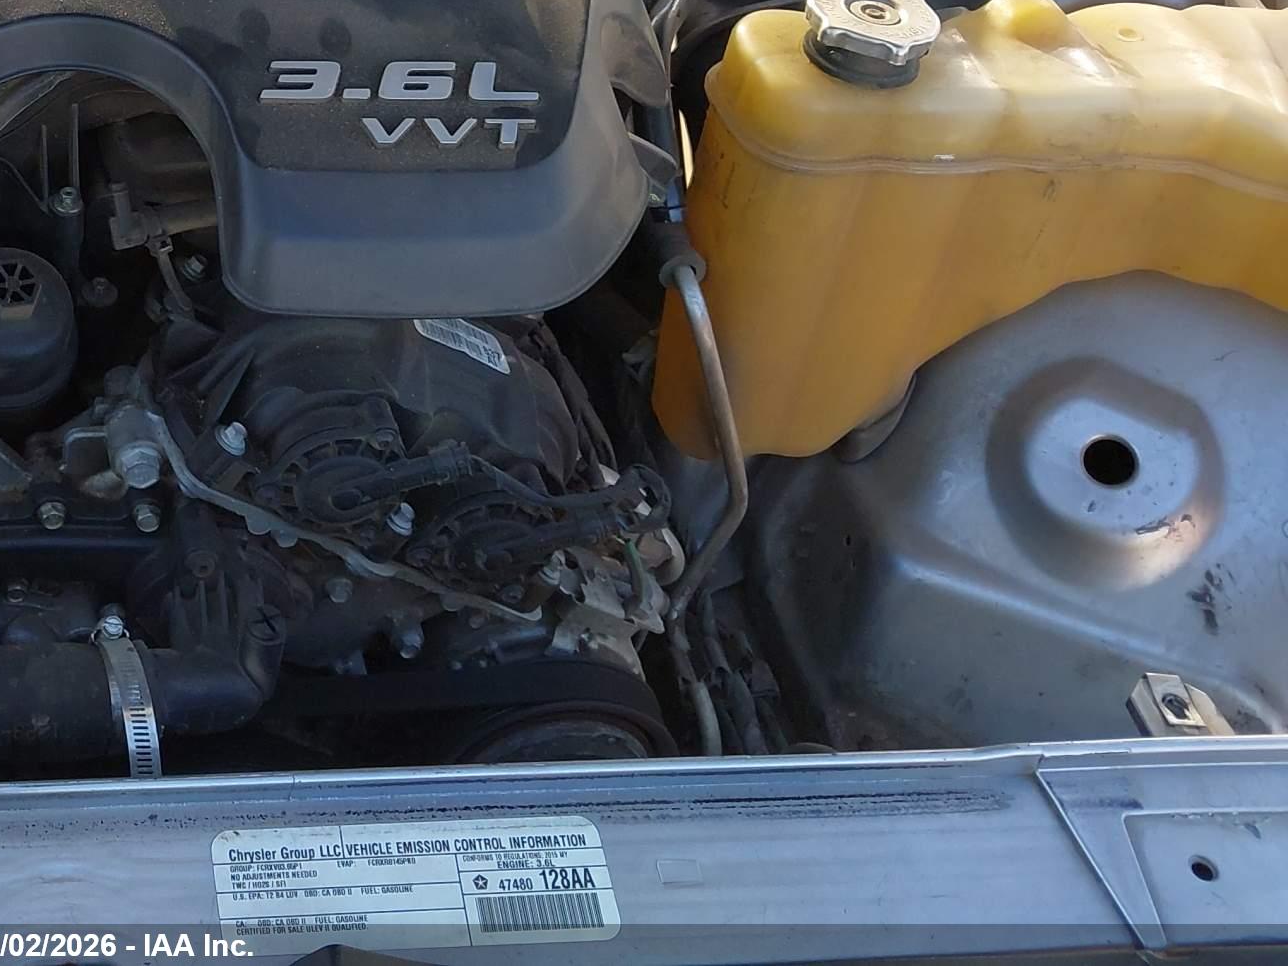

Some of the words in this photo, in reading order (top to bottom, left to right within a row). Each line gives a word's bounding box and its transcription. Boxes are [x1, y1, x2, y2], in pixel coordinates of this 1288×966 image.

[259, 60, 540, 102] 3.6L
[362, 117, 537, 147] VVT
[229, 848, 276, 863] Chrysler
[281, 847, 315, 860] Group
[320, 845, 342, 857] LLC
[346, 842, 392, 856] VEHICLE
[396, 840, 450, 854] EMISSION
[454, 838, 506, 851] CONTROL
[509, 834, 586, 849] INFORMATION
[497, 861, 534, 869] ENGINE:
[536, 859, 555, 867] 3.6L
[242, 871, 290, 880] ADJUSTMENTS
[291, 870, 318, 878] NEEDED
[499, 878, 534, 891] 47480
[539, 868, 596, 890] 128AA
[381, 885, 413, 894] GASOLINE
[336, 914, 368, 924] GASOLINE
[236, 927, 270, 936] CERTIFIED
[273, 926, 286, 934] FOR
[287, 926, 304, 934] SALE
